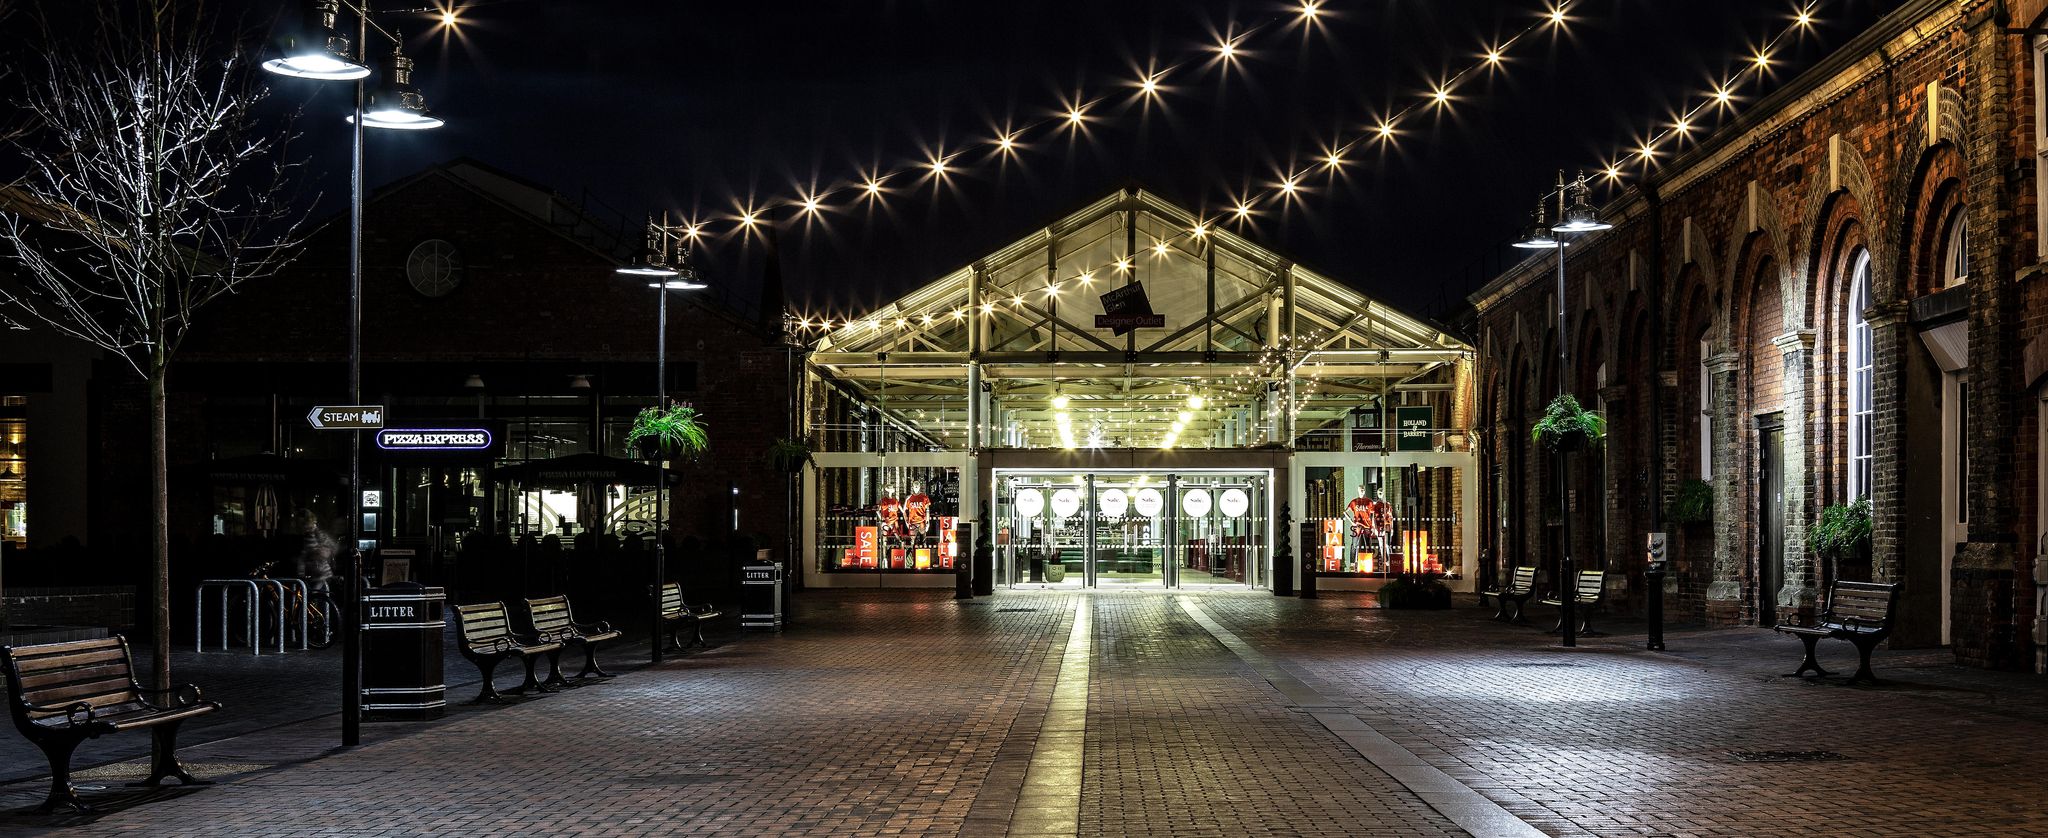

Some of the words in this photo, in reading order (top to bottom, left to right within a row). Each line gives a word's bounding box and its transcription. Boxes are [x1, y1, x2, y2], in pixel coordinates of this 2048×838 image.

[1103, 285, 1141, 305] McArthur
[1106, 300, 1126, 313] Glen
[1097, 316, 1133, 327] Designer
[1135, 316, 1163, 326] Outlet
[323, 412, 359, 422] STEAM
[860, 531, 872, 564] SALE
[370, 606, 415, 618] LITTER
